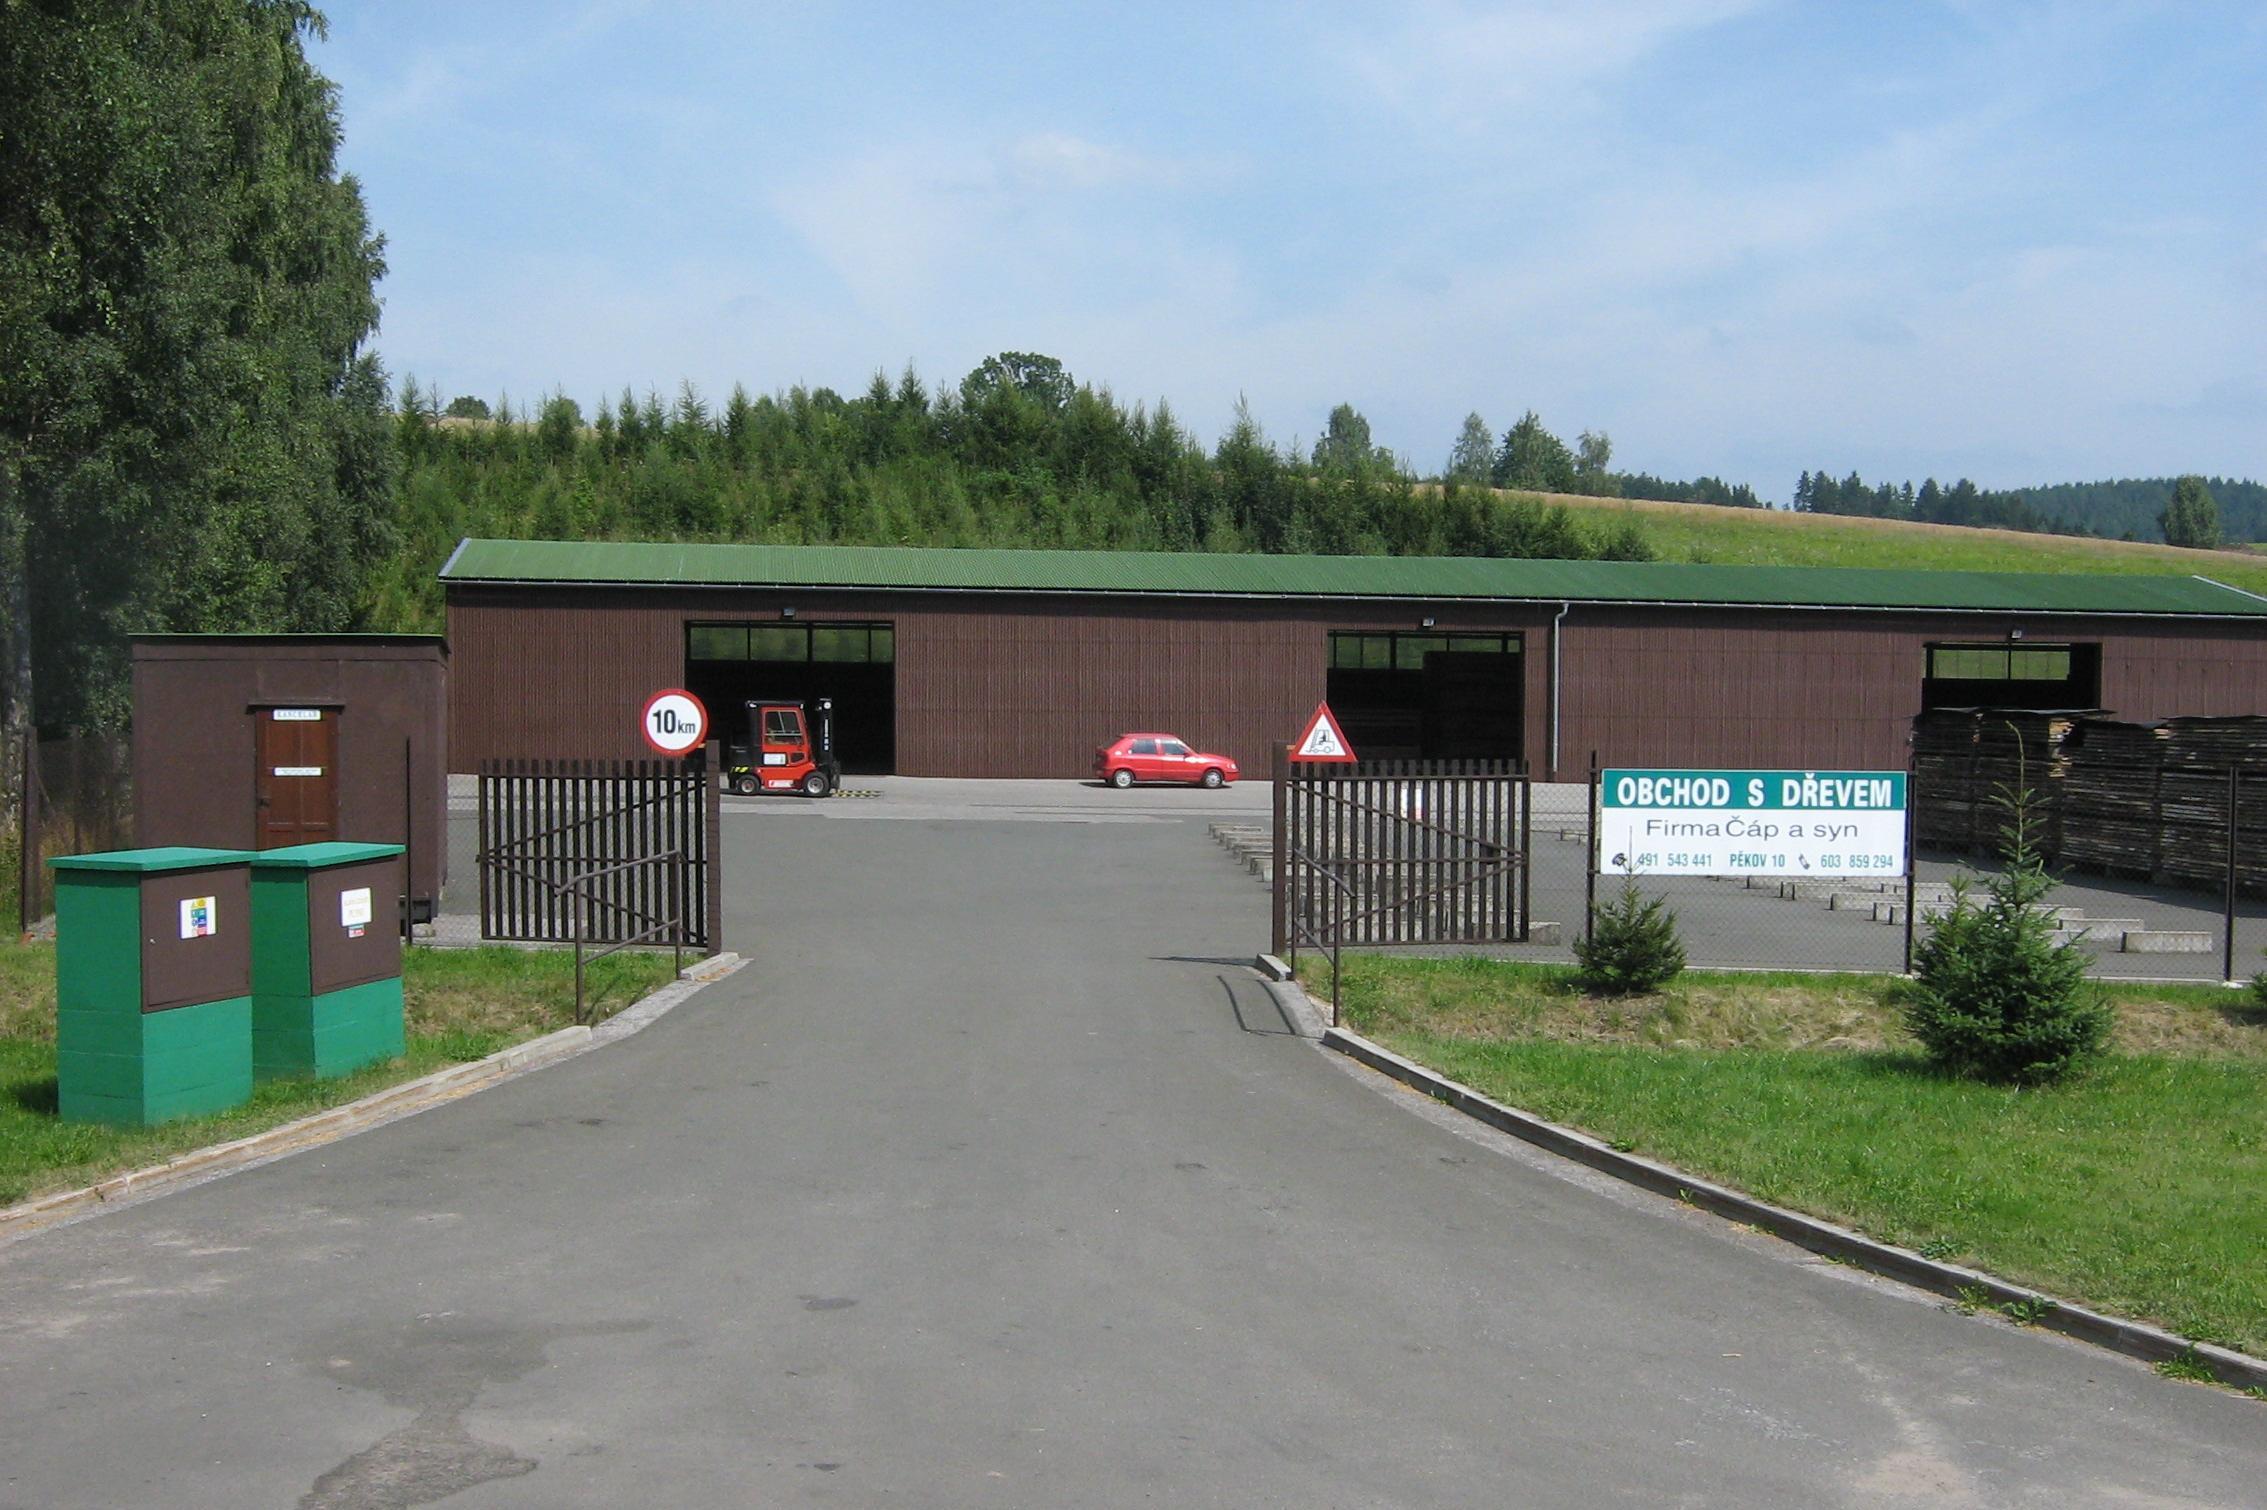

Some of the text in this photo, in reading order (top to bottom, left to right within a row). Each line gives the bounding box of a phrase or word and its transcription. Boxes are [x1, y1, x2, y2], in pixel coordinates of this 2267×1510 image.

[1617, 772, 1893, 808] OBCHOD S DŘEVEM
[1646, 815, 1859, 842] Firma Čáp a syn
[1638, 852, 1659, 867] 491
[1666, 853, 1688, 867] 543
[1692, 853, 1713, 867] 441
[1772, 853, 1786, 868] 10
[1819, 854, 1841, 869] 603
[1849, 854, 1870, 869] 859
[1872, 855, 1894, 869] 294
